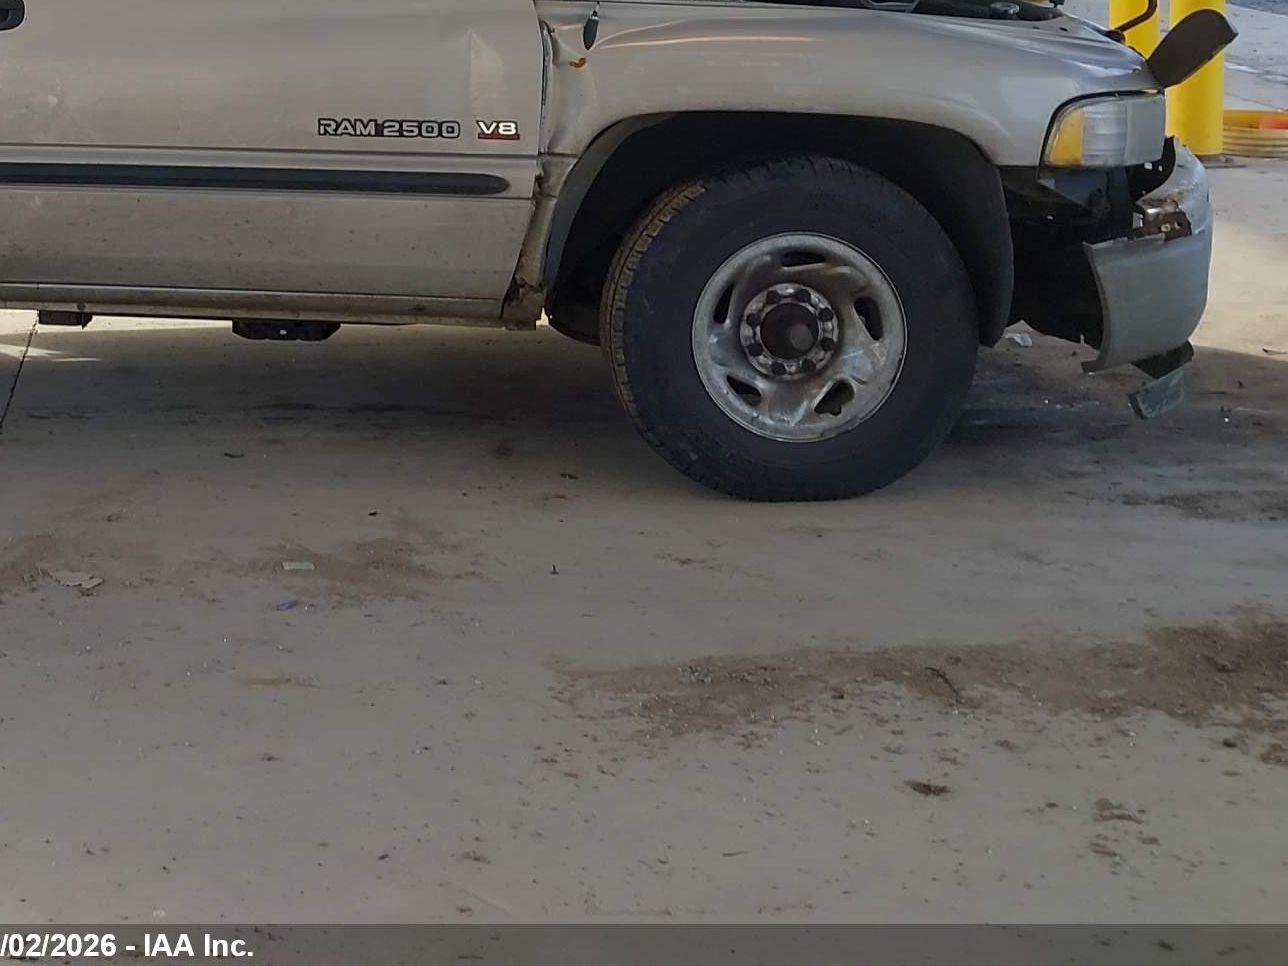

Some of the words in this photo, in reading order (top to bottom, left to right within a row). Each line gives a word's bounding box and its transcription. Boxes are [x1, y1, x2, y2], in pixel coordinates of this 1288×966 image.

[318, 118, 377, 137] RAM
[382, 120, 461, 138] 2500
[475, 120, 518, 136] V8
